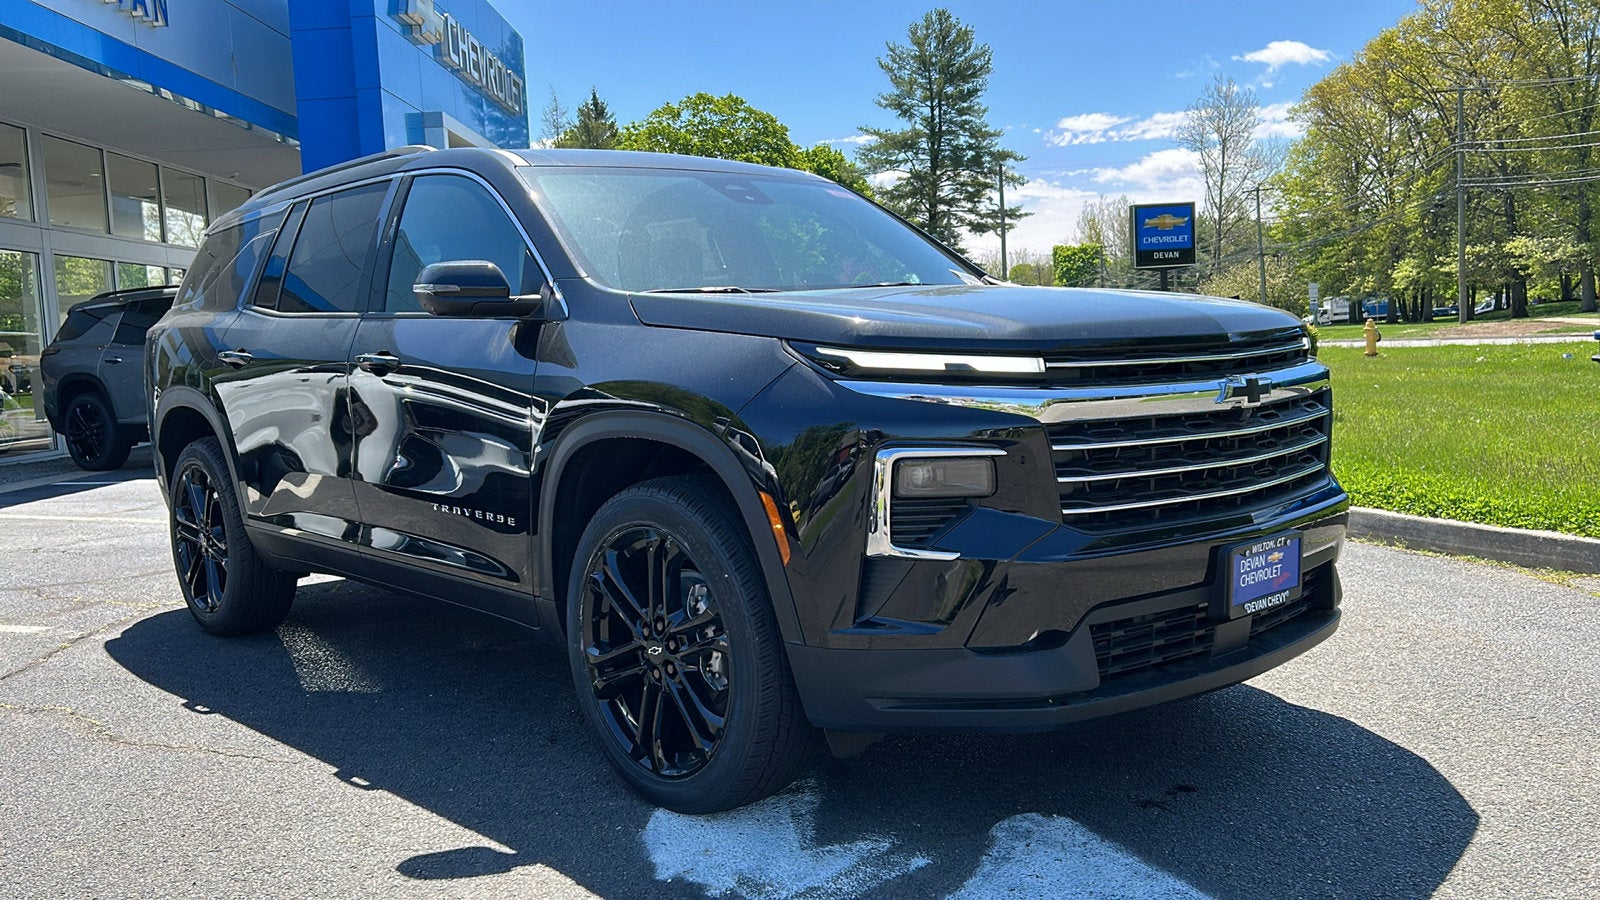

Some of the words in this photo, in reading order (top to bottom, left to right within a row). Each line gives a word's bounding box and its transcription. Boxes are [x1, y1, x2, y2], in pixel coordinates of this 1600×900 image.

[445, 12, 524, 115] CHEVROLET
[1143, 235, 1188, 244] CHEVROLET
[1153, 251, 1179, 259] DEVAN
[431, 503, 516, 526] TRAVERSE
[1276, 537, 1285, 547] CT
[1240, 554, 1266, 573] DEVAN
[1240, 564, 1282, 587] CHEVROLET
